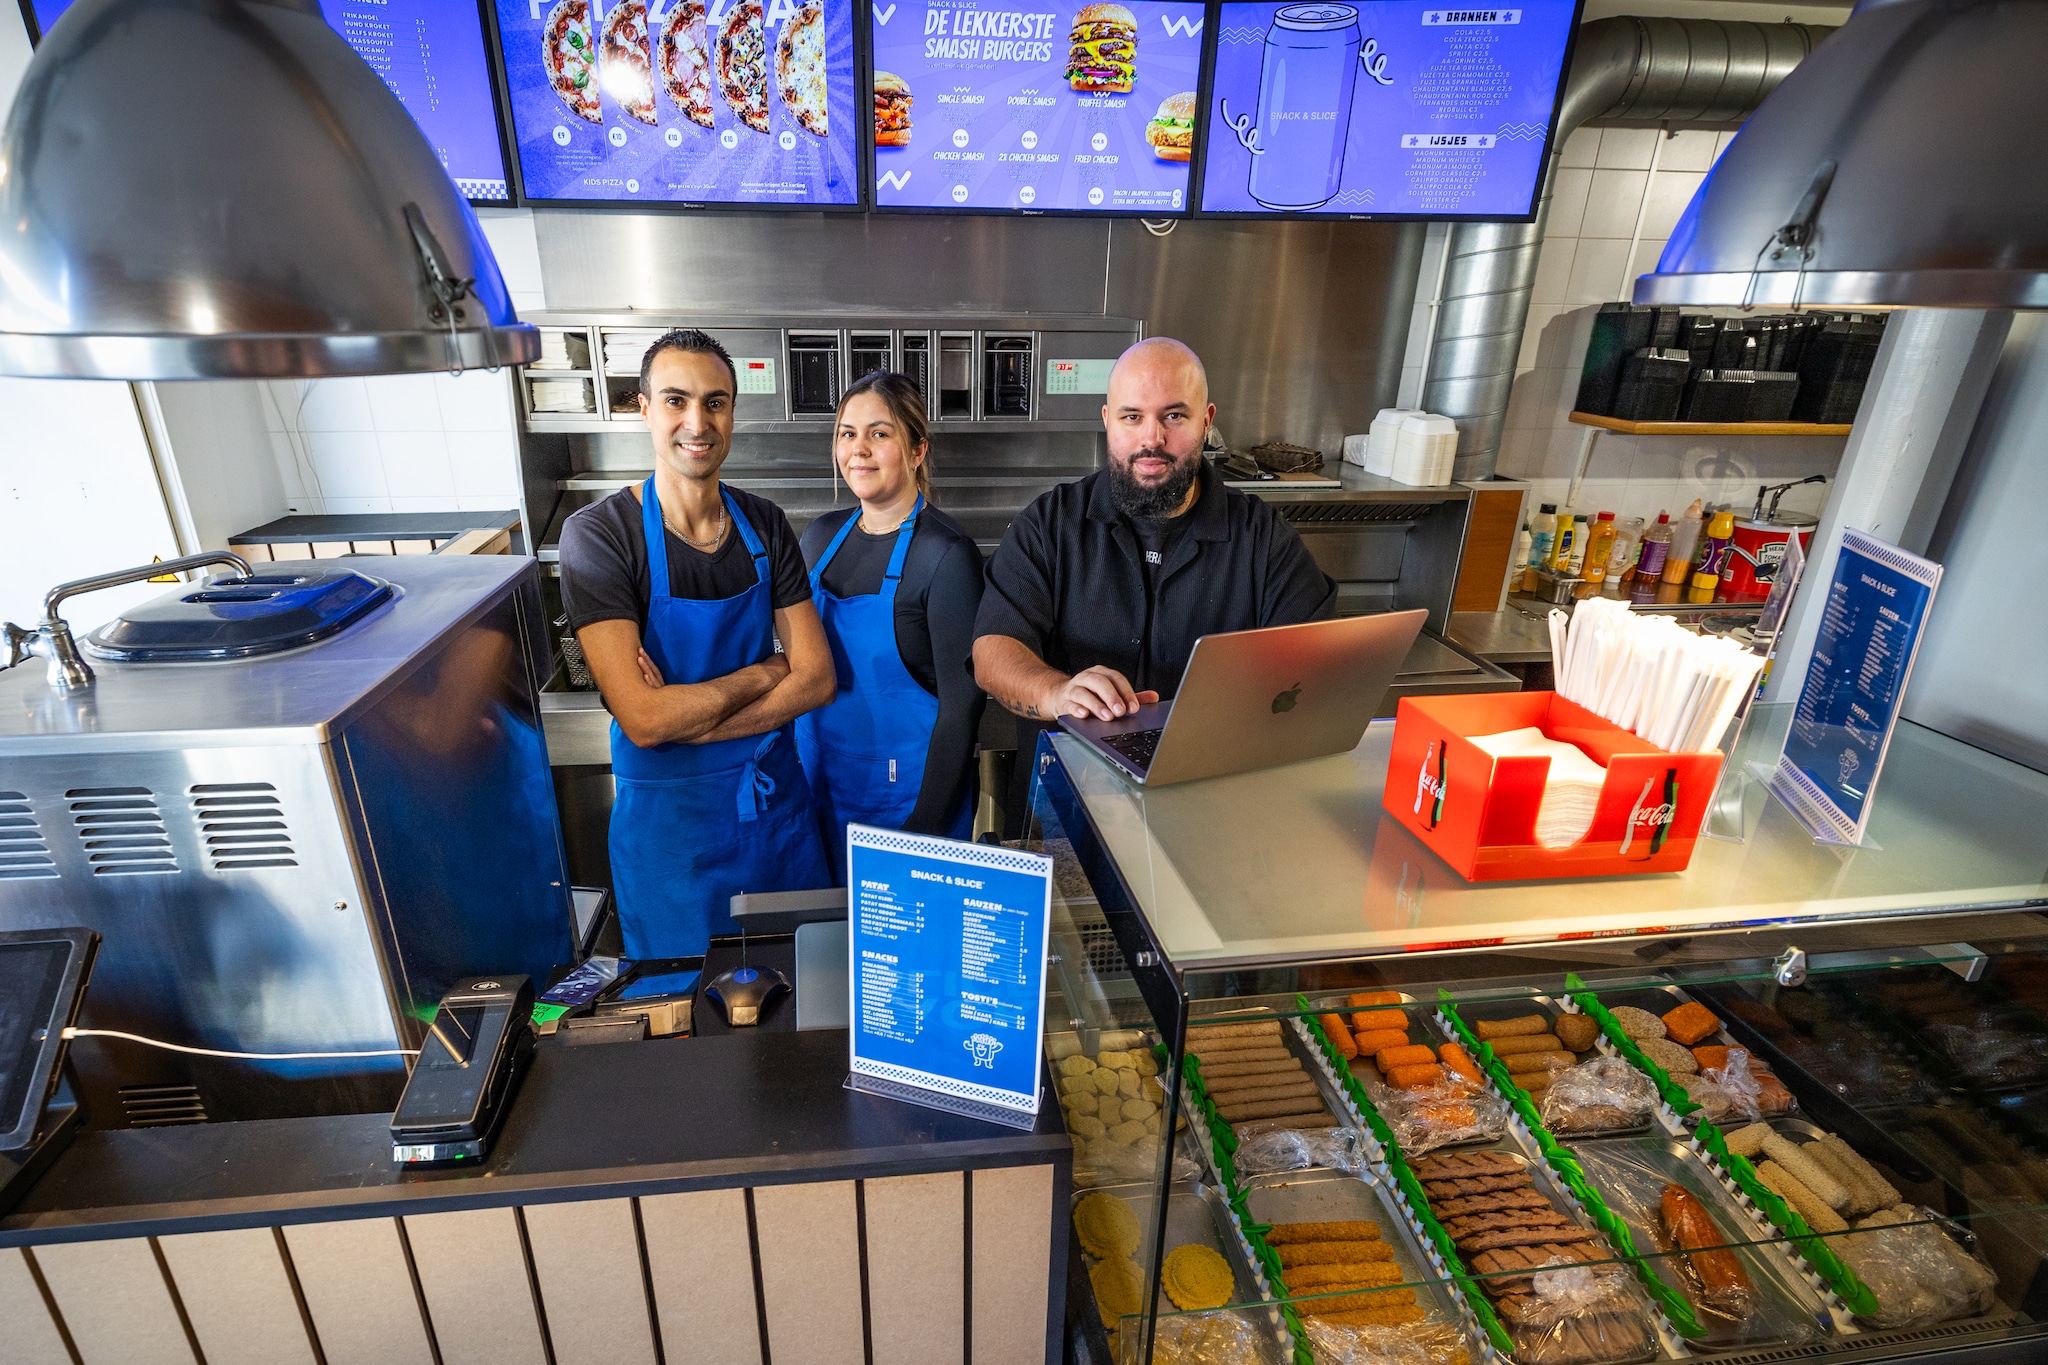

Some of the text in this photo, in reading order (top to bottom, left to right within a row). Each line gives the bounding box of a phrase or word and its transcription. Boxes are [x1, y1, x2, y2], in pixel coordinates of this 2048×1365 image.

[927, 0, 950, 8] SNACK
[342, 12, 379, 21] FRIKANDEL
[1446, 11, 1497, 22] DRANKEN
[344, 20, 363, 28] RUND
[924, 9, 1056, 39] DE LEKKERSTE
[345, 29, 367, 37] KALFS
[368, 31, 394, 39] KROKET
[925, 38, 1053, 63] SMASH BURGERS
[937, 94, 985, 105] SINGLE SMASH
[1007, 96, 1056, 106] DOUBLE SMASH
[1103, 99, 1127, 108] SMASH
[554, 105, 583, 131] Margherita
[1270, 111, 1337, 120] SNACK & SLICE
[616, 114, 644, 135] Pepperoni
[1430, 136, 1467, 145] IJSJES
[933, 151, 985, 161] CHICKEN SMASH
[1008, 153, 1035, 162] CHICKEN
[1036, 154, 1060, 163] SMASH
[1074, 154, 1119, 164] FRIED CHICKEN
[583, 178, 625, 186] KIDS PIZZA
[910, 869, 983, 889] SNACK & SLICE
[861, 880, 890, 891] PATAT
[860, 892, 878, 900] PATAT
[963, 898, 1002, 911] SAUZEN
[861, 906, 878, 914] PATAT
[862, 950, 898, 963] SNACKS
[961, 991, 998, 1005] TOSTI'S
